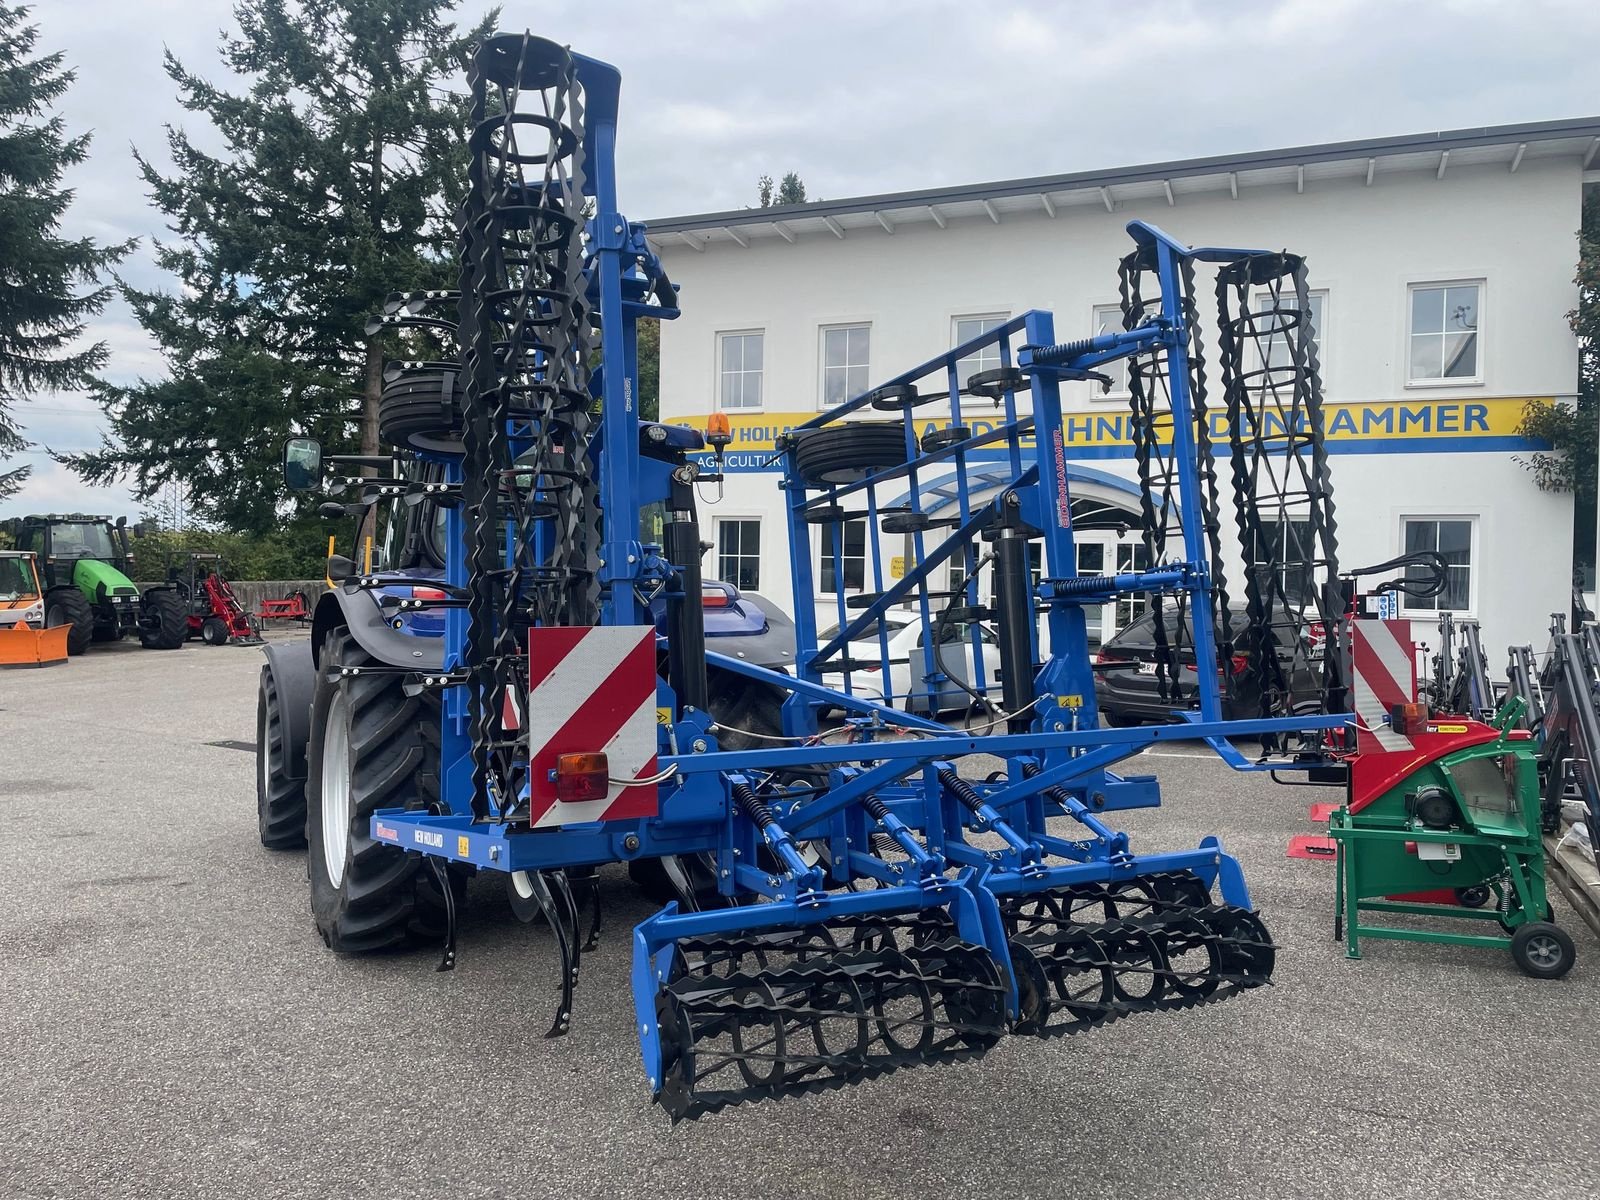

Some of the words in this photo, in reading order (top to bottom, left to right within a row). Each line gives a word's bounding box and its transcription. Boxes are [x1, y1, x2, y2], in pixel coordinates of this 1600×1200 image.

[1207, 403, 1490, 438] DENHAMMER
[697, 454, 785, 468] AGRICULTUR
[424, 832, 443, 848] HOLLAND
